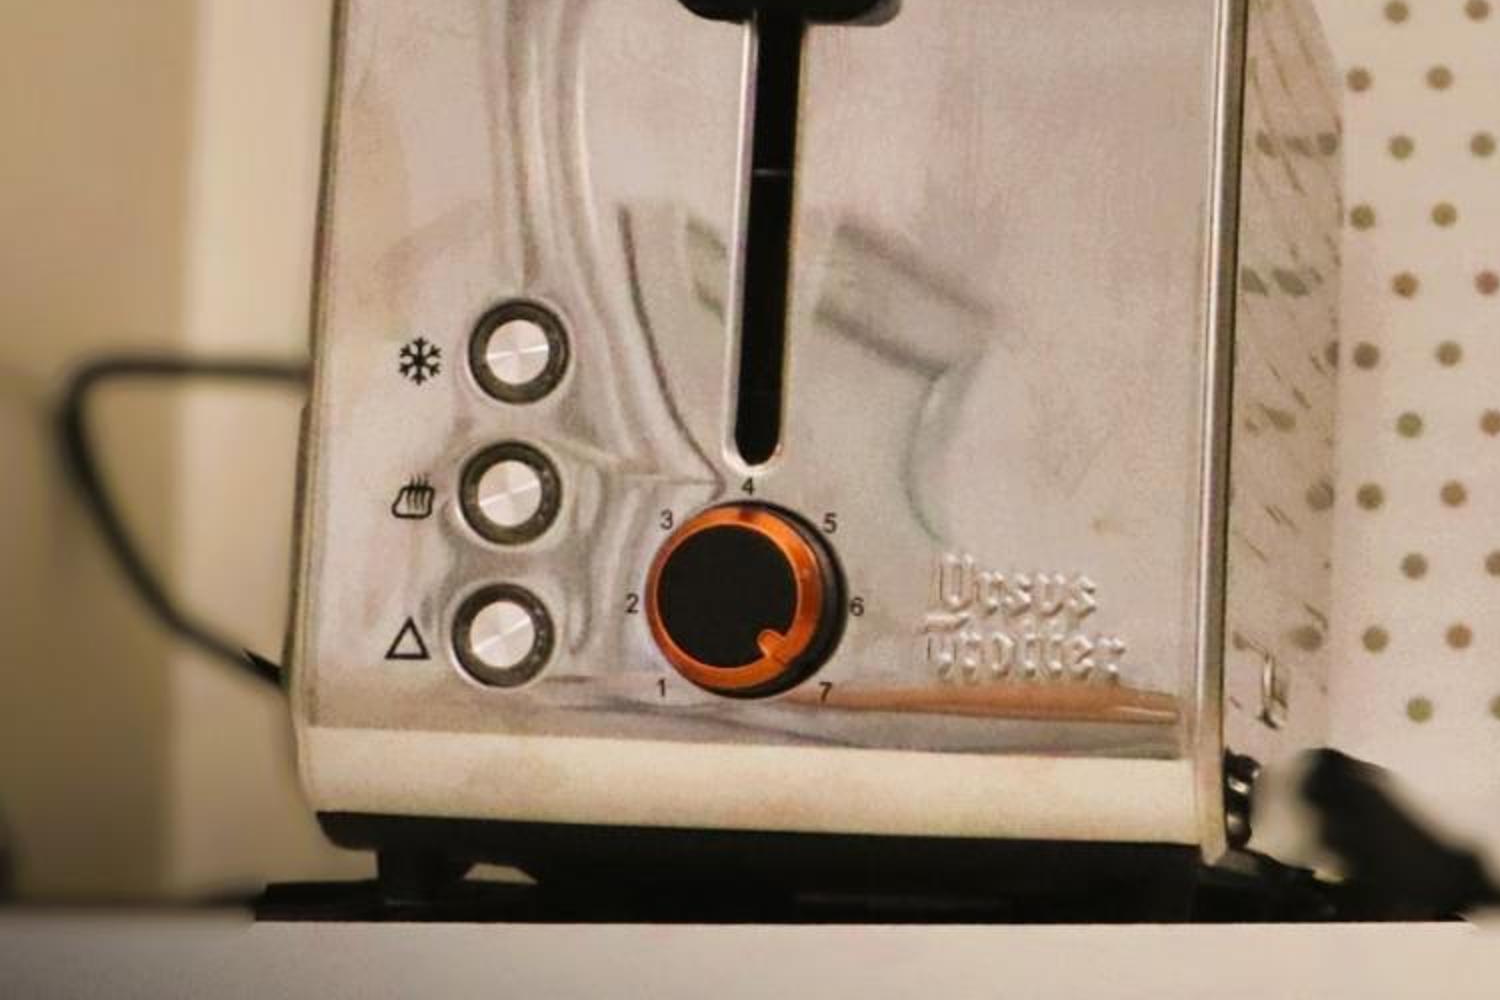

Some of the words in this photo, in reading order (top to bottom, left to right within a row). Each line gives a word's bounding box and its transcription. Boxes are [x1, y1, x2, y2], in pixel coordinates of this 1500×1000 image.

[741, 477, 756, 495] 4
[659, 510, 674, 530] 3
[822, 513, 838, 534] 5
[934, 552, 1098, 617] Ursus
[625, 593, 640, 614] 2
[849, 597, 865, 617] 6
[656, 678, 667, 697] 1
[818, 681, 833, 702] 7
